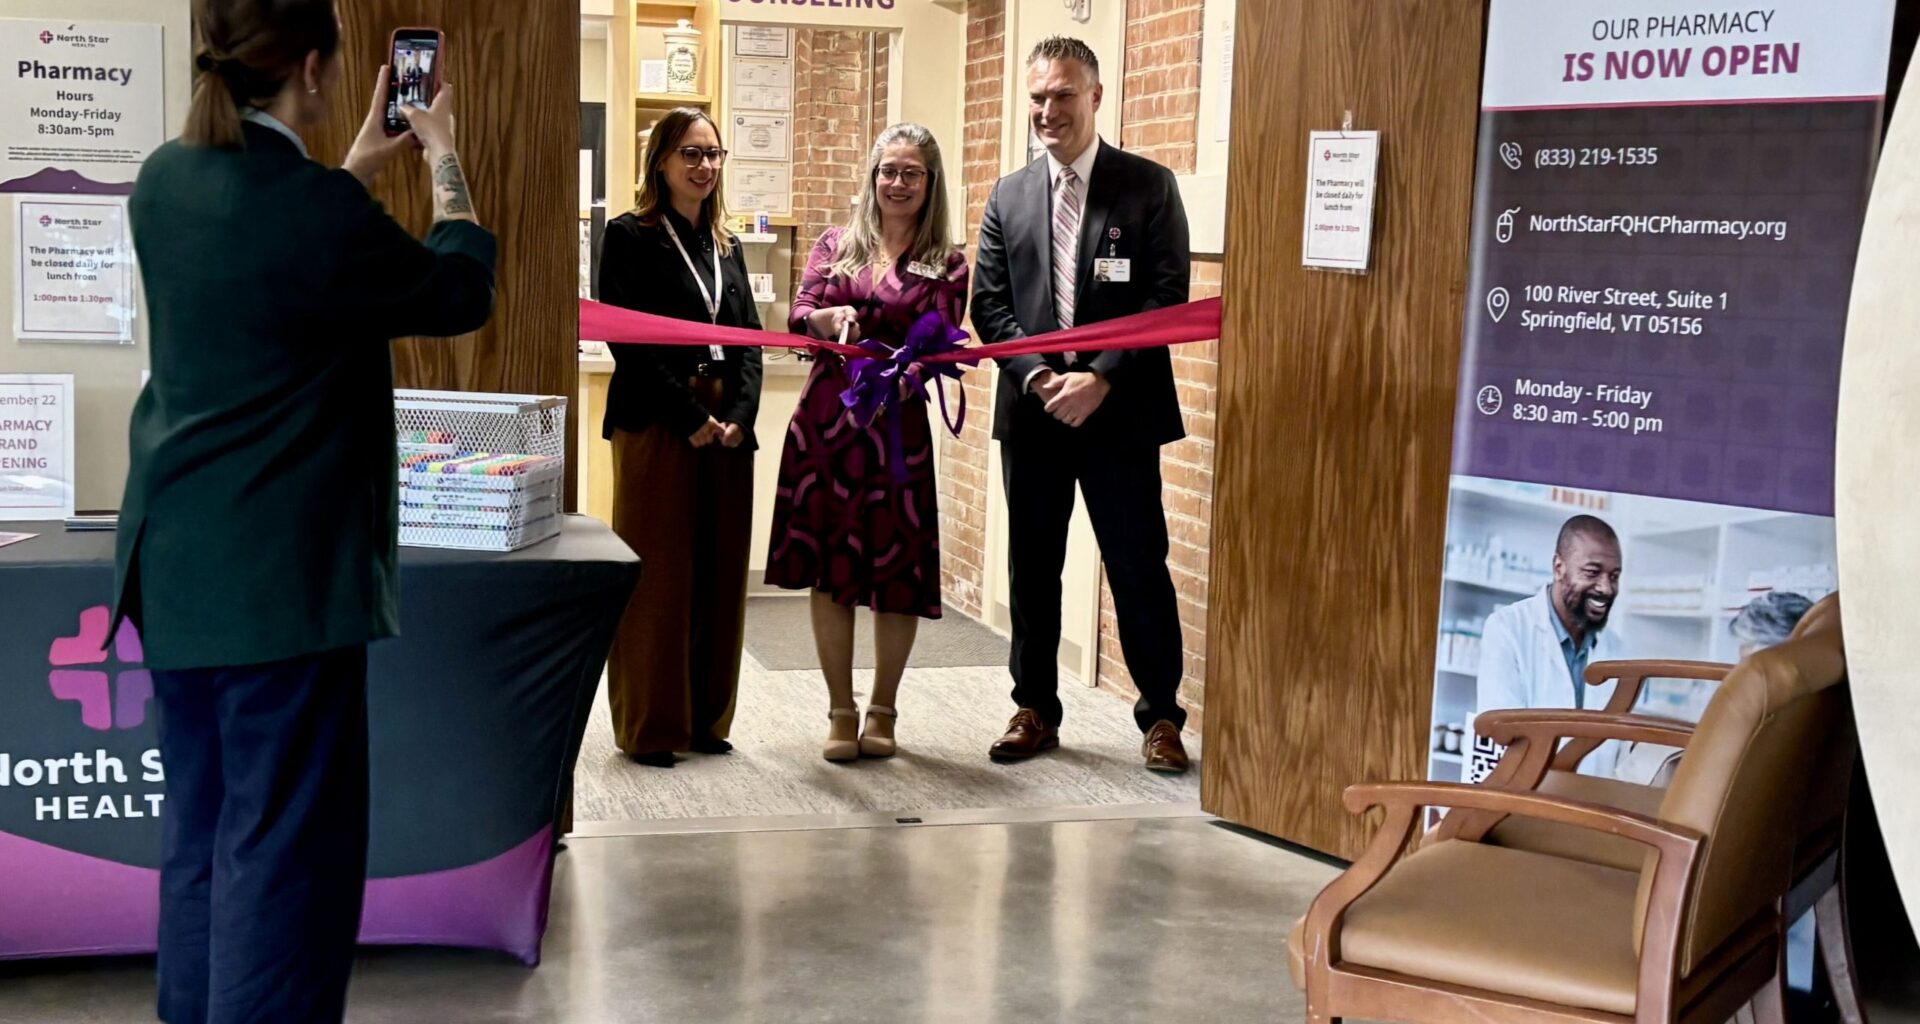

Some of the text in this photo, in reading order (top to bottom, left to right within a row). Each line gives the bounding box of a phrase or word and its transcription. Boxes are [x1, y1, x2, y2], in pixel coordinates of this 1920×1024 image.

[1592, 9, 1775, 41] OUR PHARMACY
[56, 33, 110, 44] North Star
[1562, 42, 1801, 82] IS NOW OPEN
[18, 60, 133, 86] Pharmacy
[56, 90, 94, 102] Hours
[30, 107, 122, 122] Monday-Friday
[38, 124, 115, 138] 8:30am-5pm
[1534, 147, 1659, 169] (833) 219-1535
[1529, 214, 1787, 241] NorthStarFQHCPharmacy.org
[29, 246, 114, 257] The Pharmacy will
[31, 259, 115, 271] be closed daily for
[47, 271, 97, 281] lunch from
[33, 293, 114, 305] 1:00pm to 1:30pm
[1523, 285, 1728, 310] 100 River Street, Suite 1
[1520, 310, 1703, 336] Springfield, VT 05156
[0, 394, 57, 406] ember 22
[1515, 379, 1584, 405] Monday
[1596, 384, 1653, 409] Friday
[0, 419, 52, 431] RMACY
[1513, 403, 1549, 422] 8:30
[1552, 410, 1578, 425] am
[1592, 410, 1630, 429] 5:00
[1634, 415, 1663, 435] pm
[0, 438, 38, 450] RAND
[0, 457, 48, 469] ENING
[35, 793, 165, 821] HEALT
